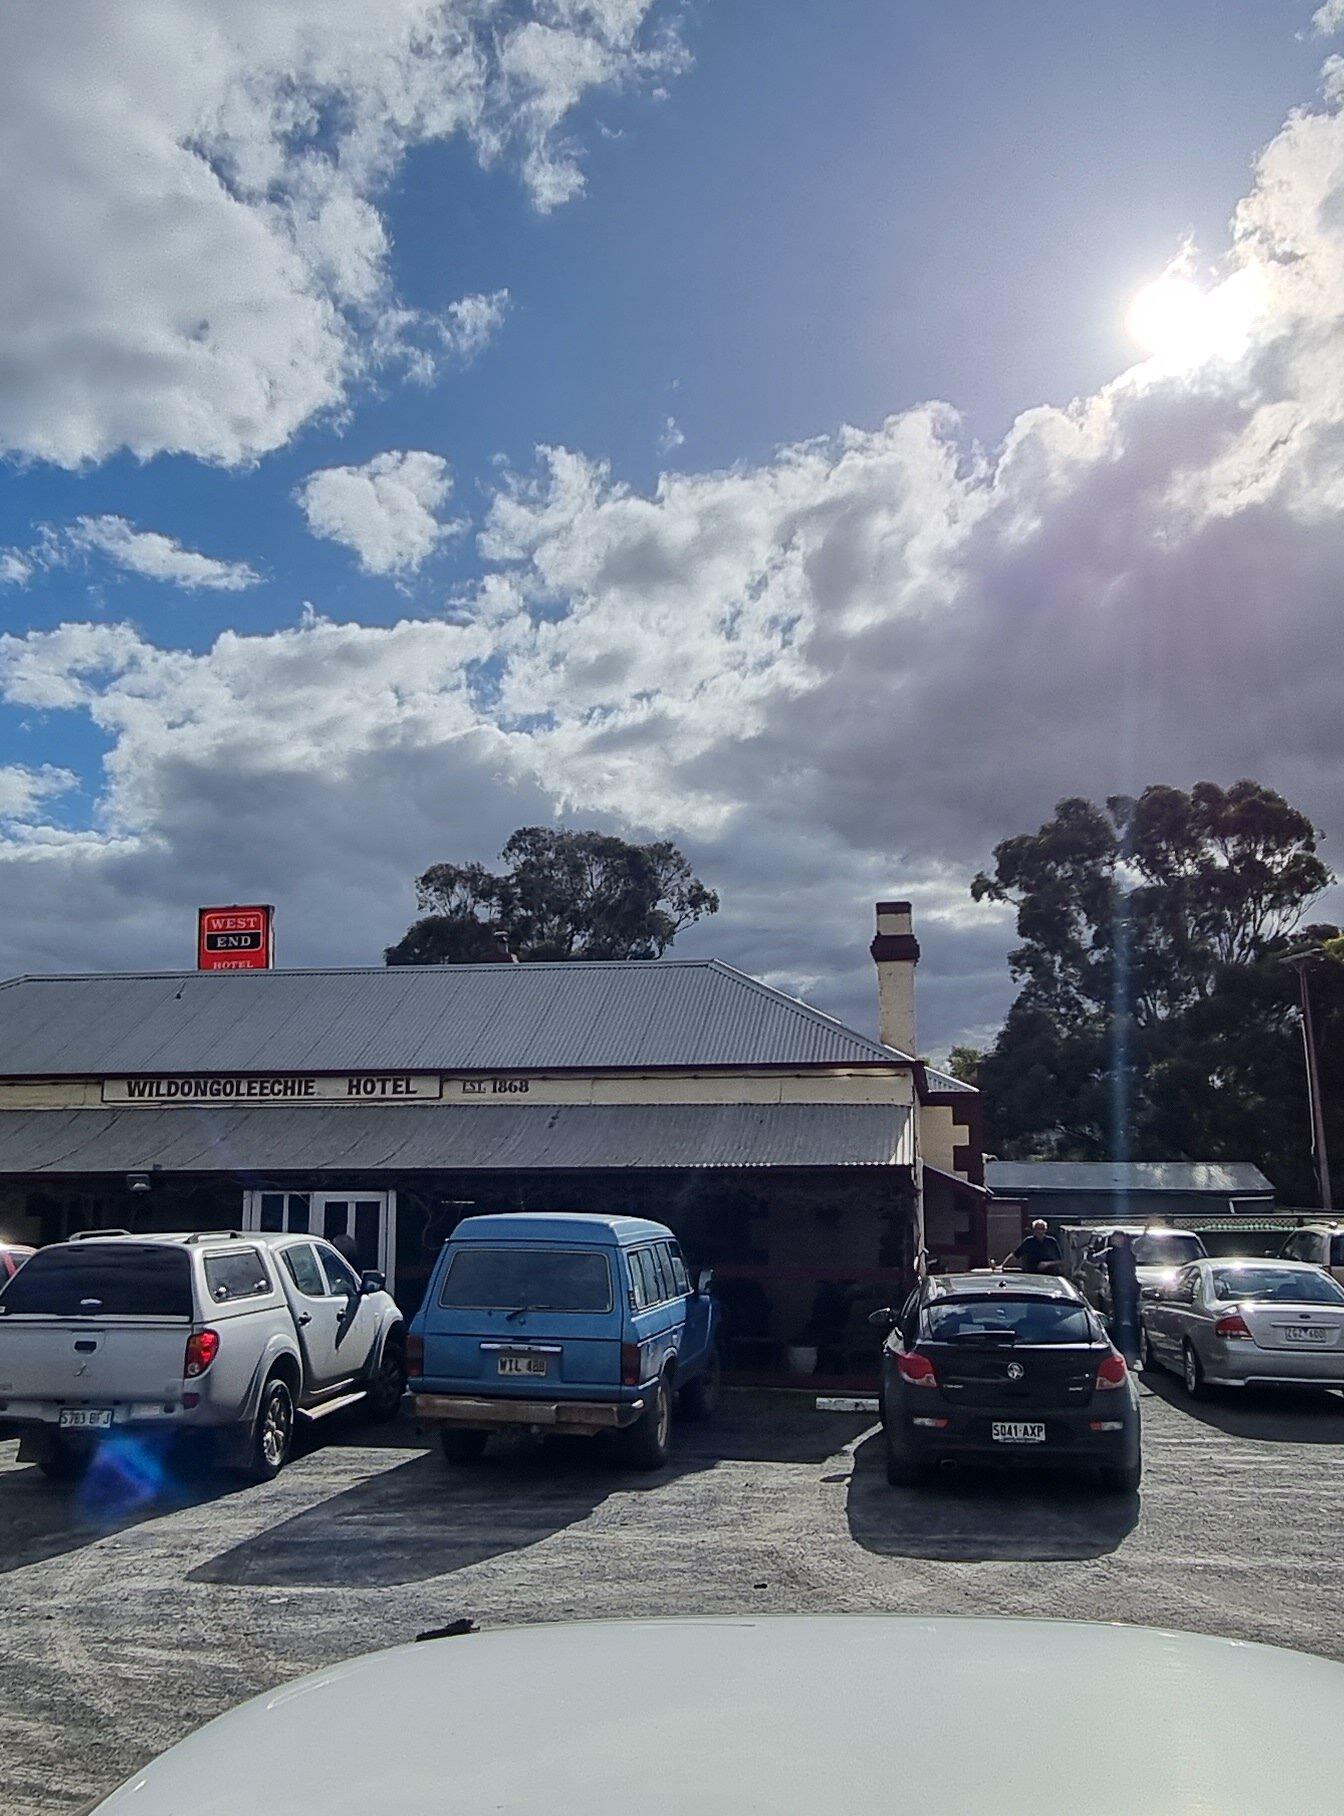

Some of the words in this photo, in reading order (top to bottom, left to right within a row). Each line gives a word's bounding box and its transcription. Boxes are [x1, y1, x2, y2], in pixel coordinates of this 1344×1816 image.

[212, 918, 256, 929] WEST
[217, 936, 251, 948] END
[213, 961, 254, 970] HOTEL
[127, 1079, 316, 1098] WILDONGOLEECHIE
[347, 1077, 418, 1096] HOTEL
[492, 1080, 529, 1094] 1868
